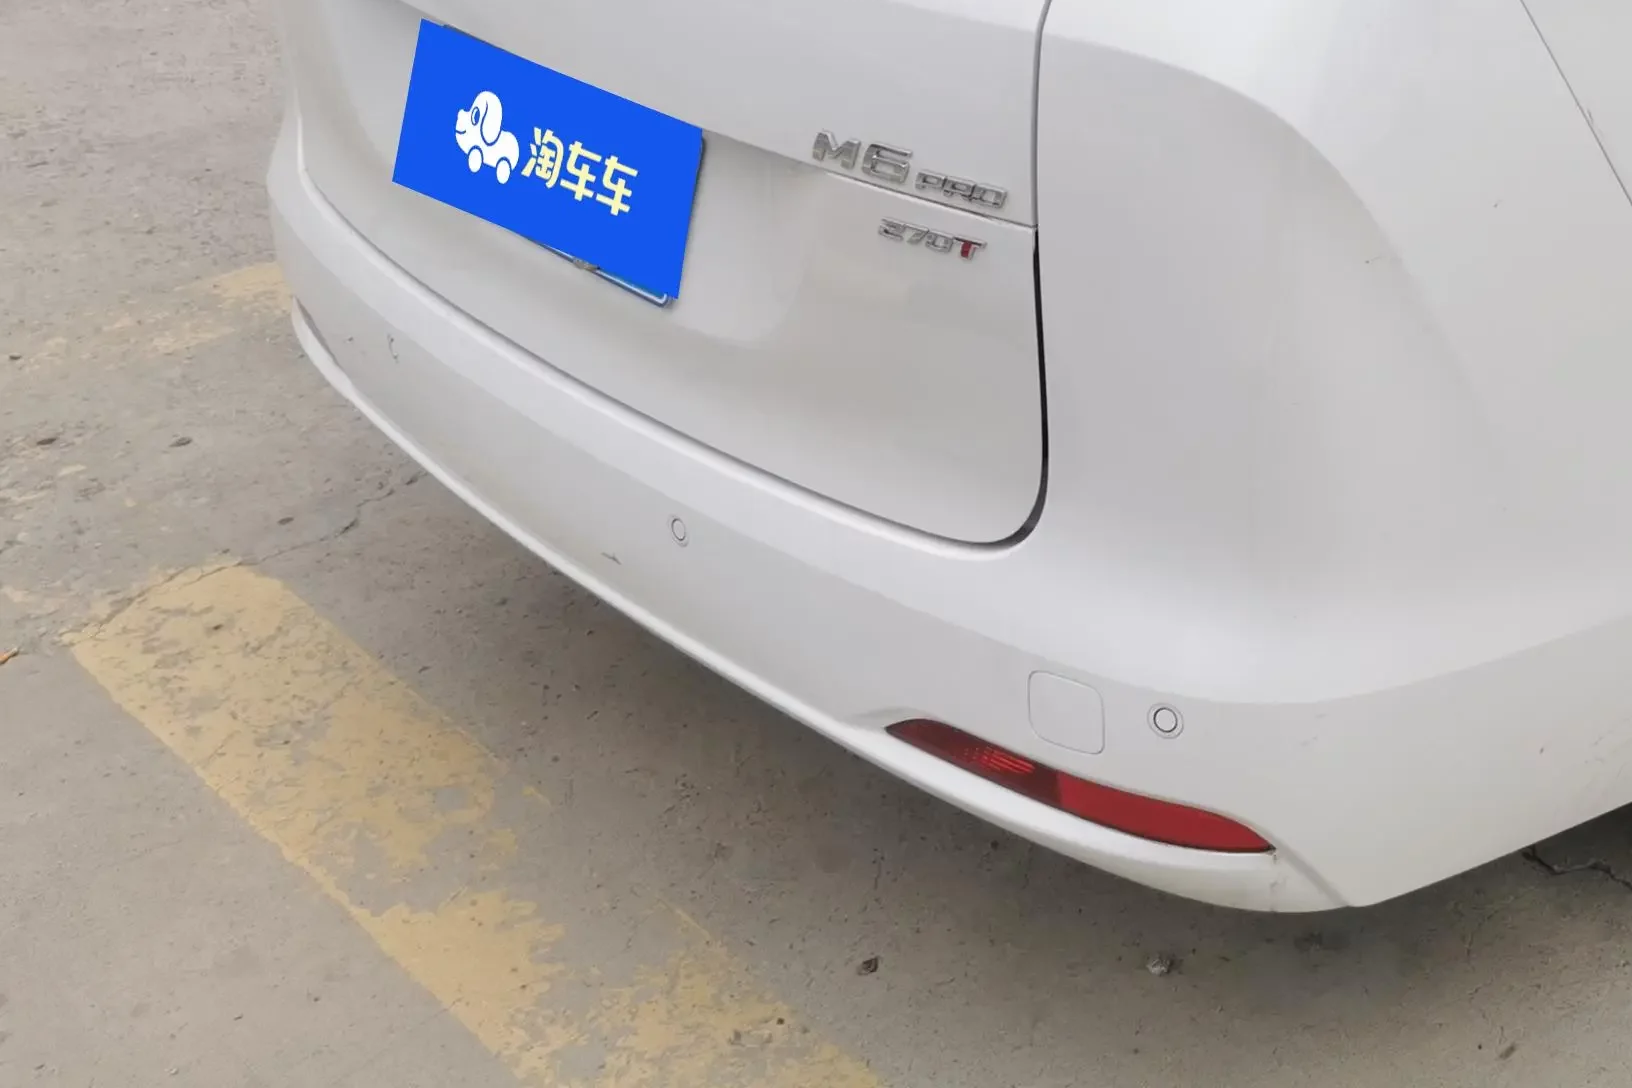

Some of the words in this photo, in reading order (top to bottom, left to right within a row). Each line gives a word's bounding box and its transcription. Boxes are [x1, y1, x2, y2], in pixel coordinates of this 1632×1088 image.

[812, 129, 914, 184] M6
[914, 169, 1008, 209] PRO
[877, 216, 988, 261] 270T
